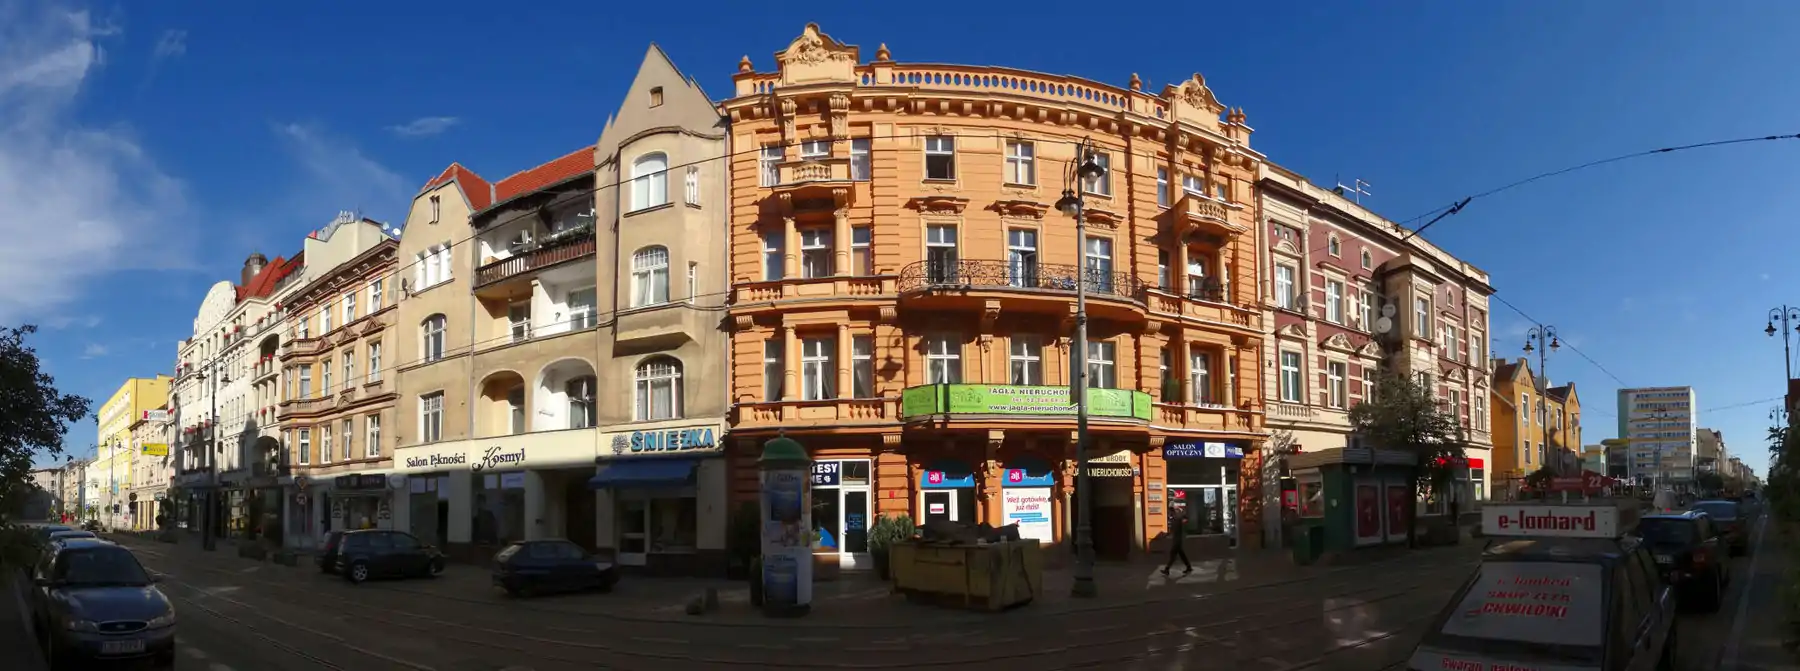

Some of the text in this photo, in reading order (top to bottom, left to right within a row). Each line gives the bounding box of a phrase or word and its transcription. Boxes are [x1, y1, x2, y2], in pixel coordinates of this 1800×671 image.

[1166, 450, 1203, 458] OPTYCZNY
[406, 456, 429, 468] Salon
[1588, 476, 1602, 488] 22
